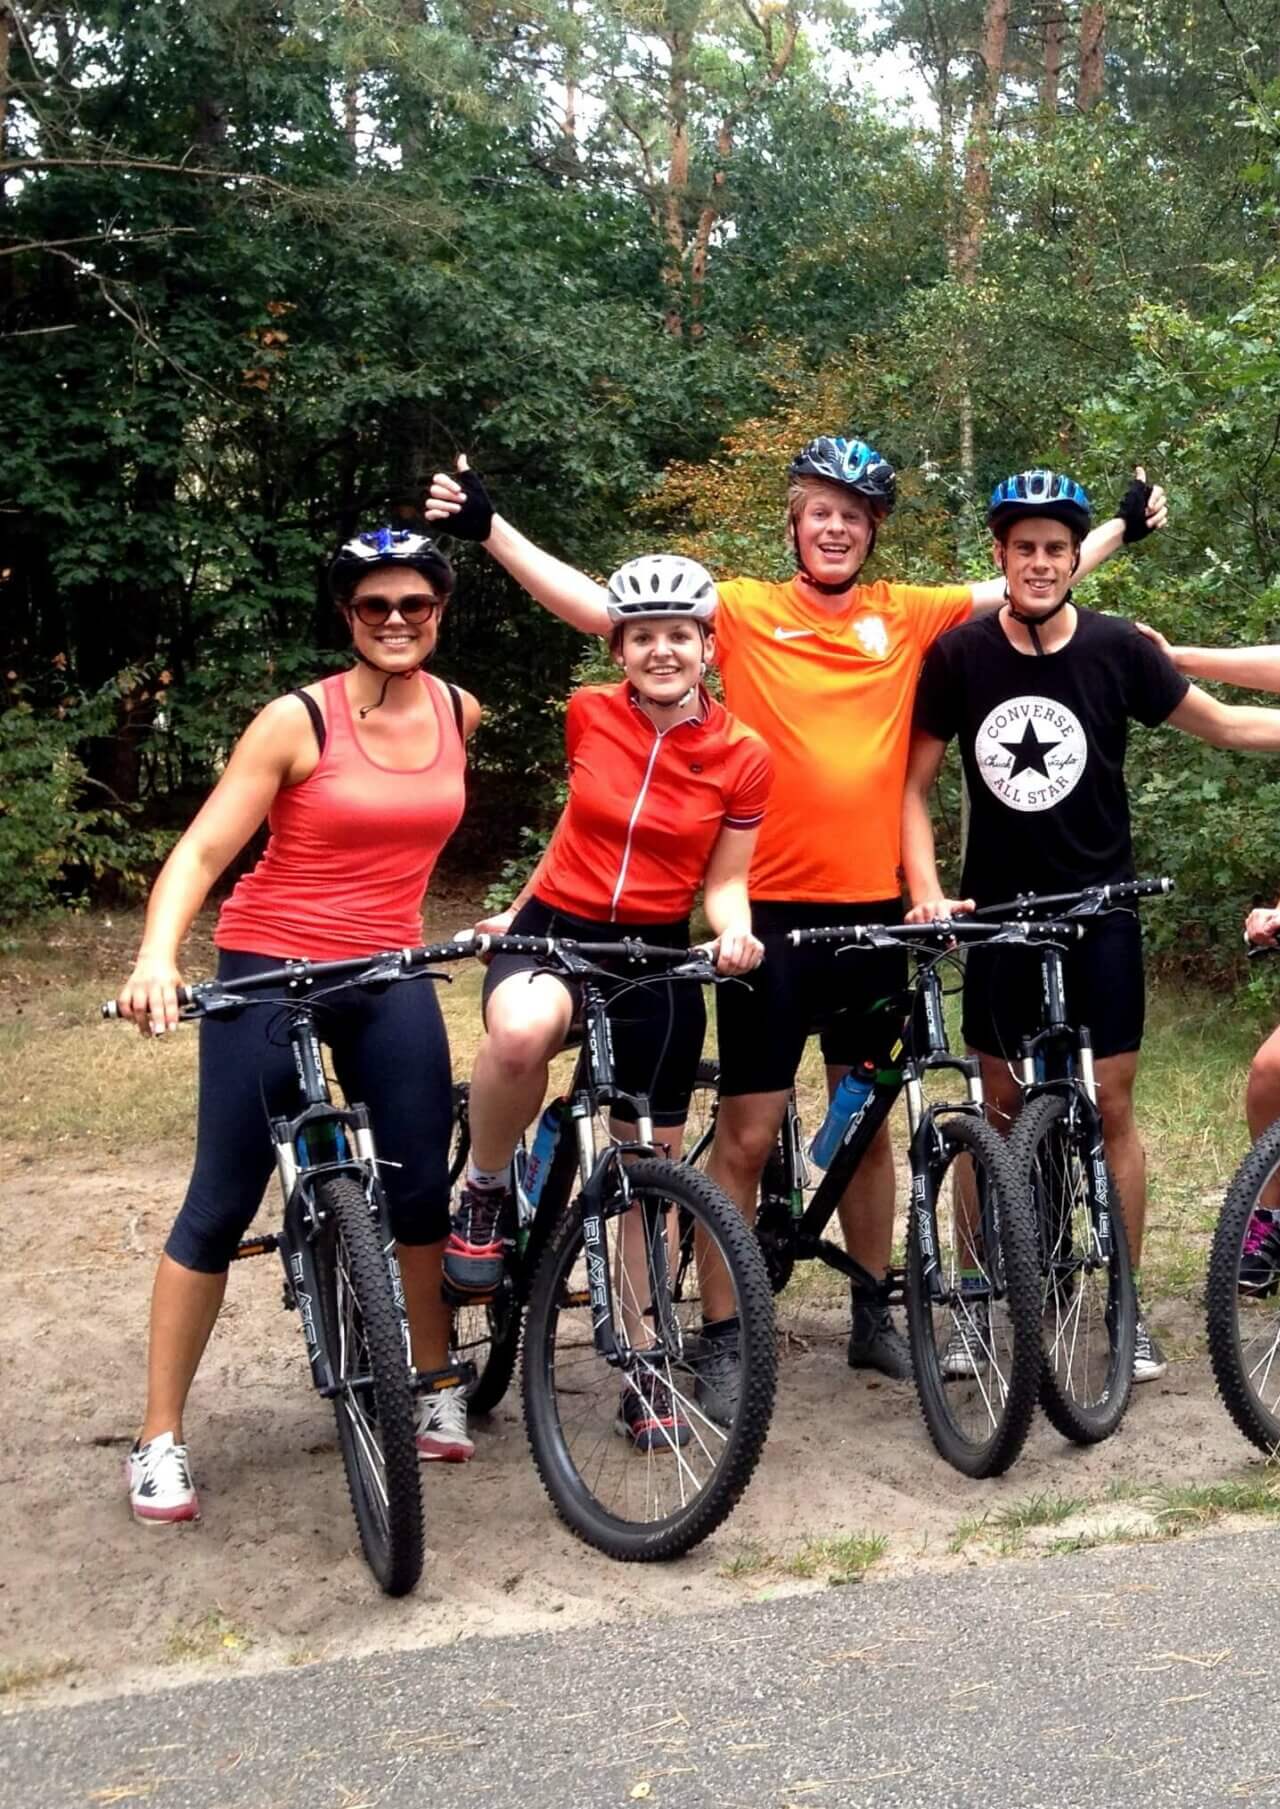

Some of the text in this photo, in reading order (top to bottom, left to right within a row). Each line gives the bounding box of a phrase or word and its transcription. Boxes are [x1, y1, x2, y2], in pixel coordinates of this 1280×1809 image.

[987, 704, 1075, 739] CONVERSE
[994, 775, 1070, 805] ALL STAR
[912, 1174, 934, 1256] BLAZE
[1093, 1158, 1110, 1239] BLAZE
[584, 1216, 607, 1307] BLAZE
